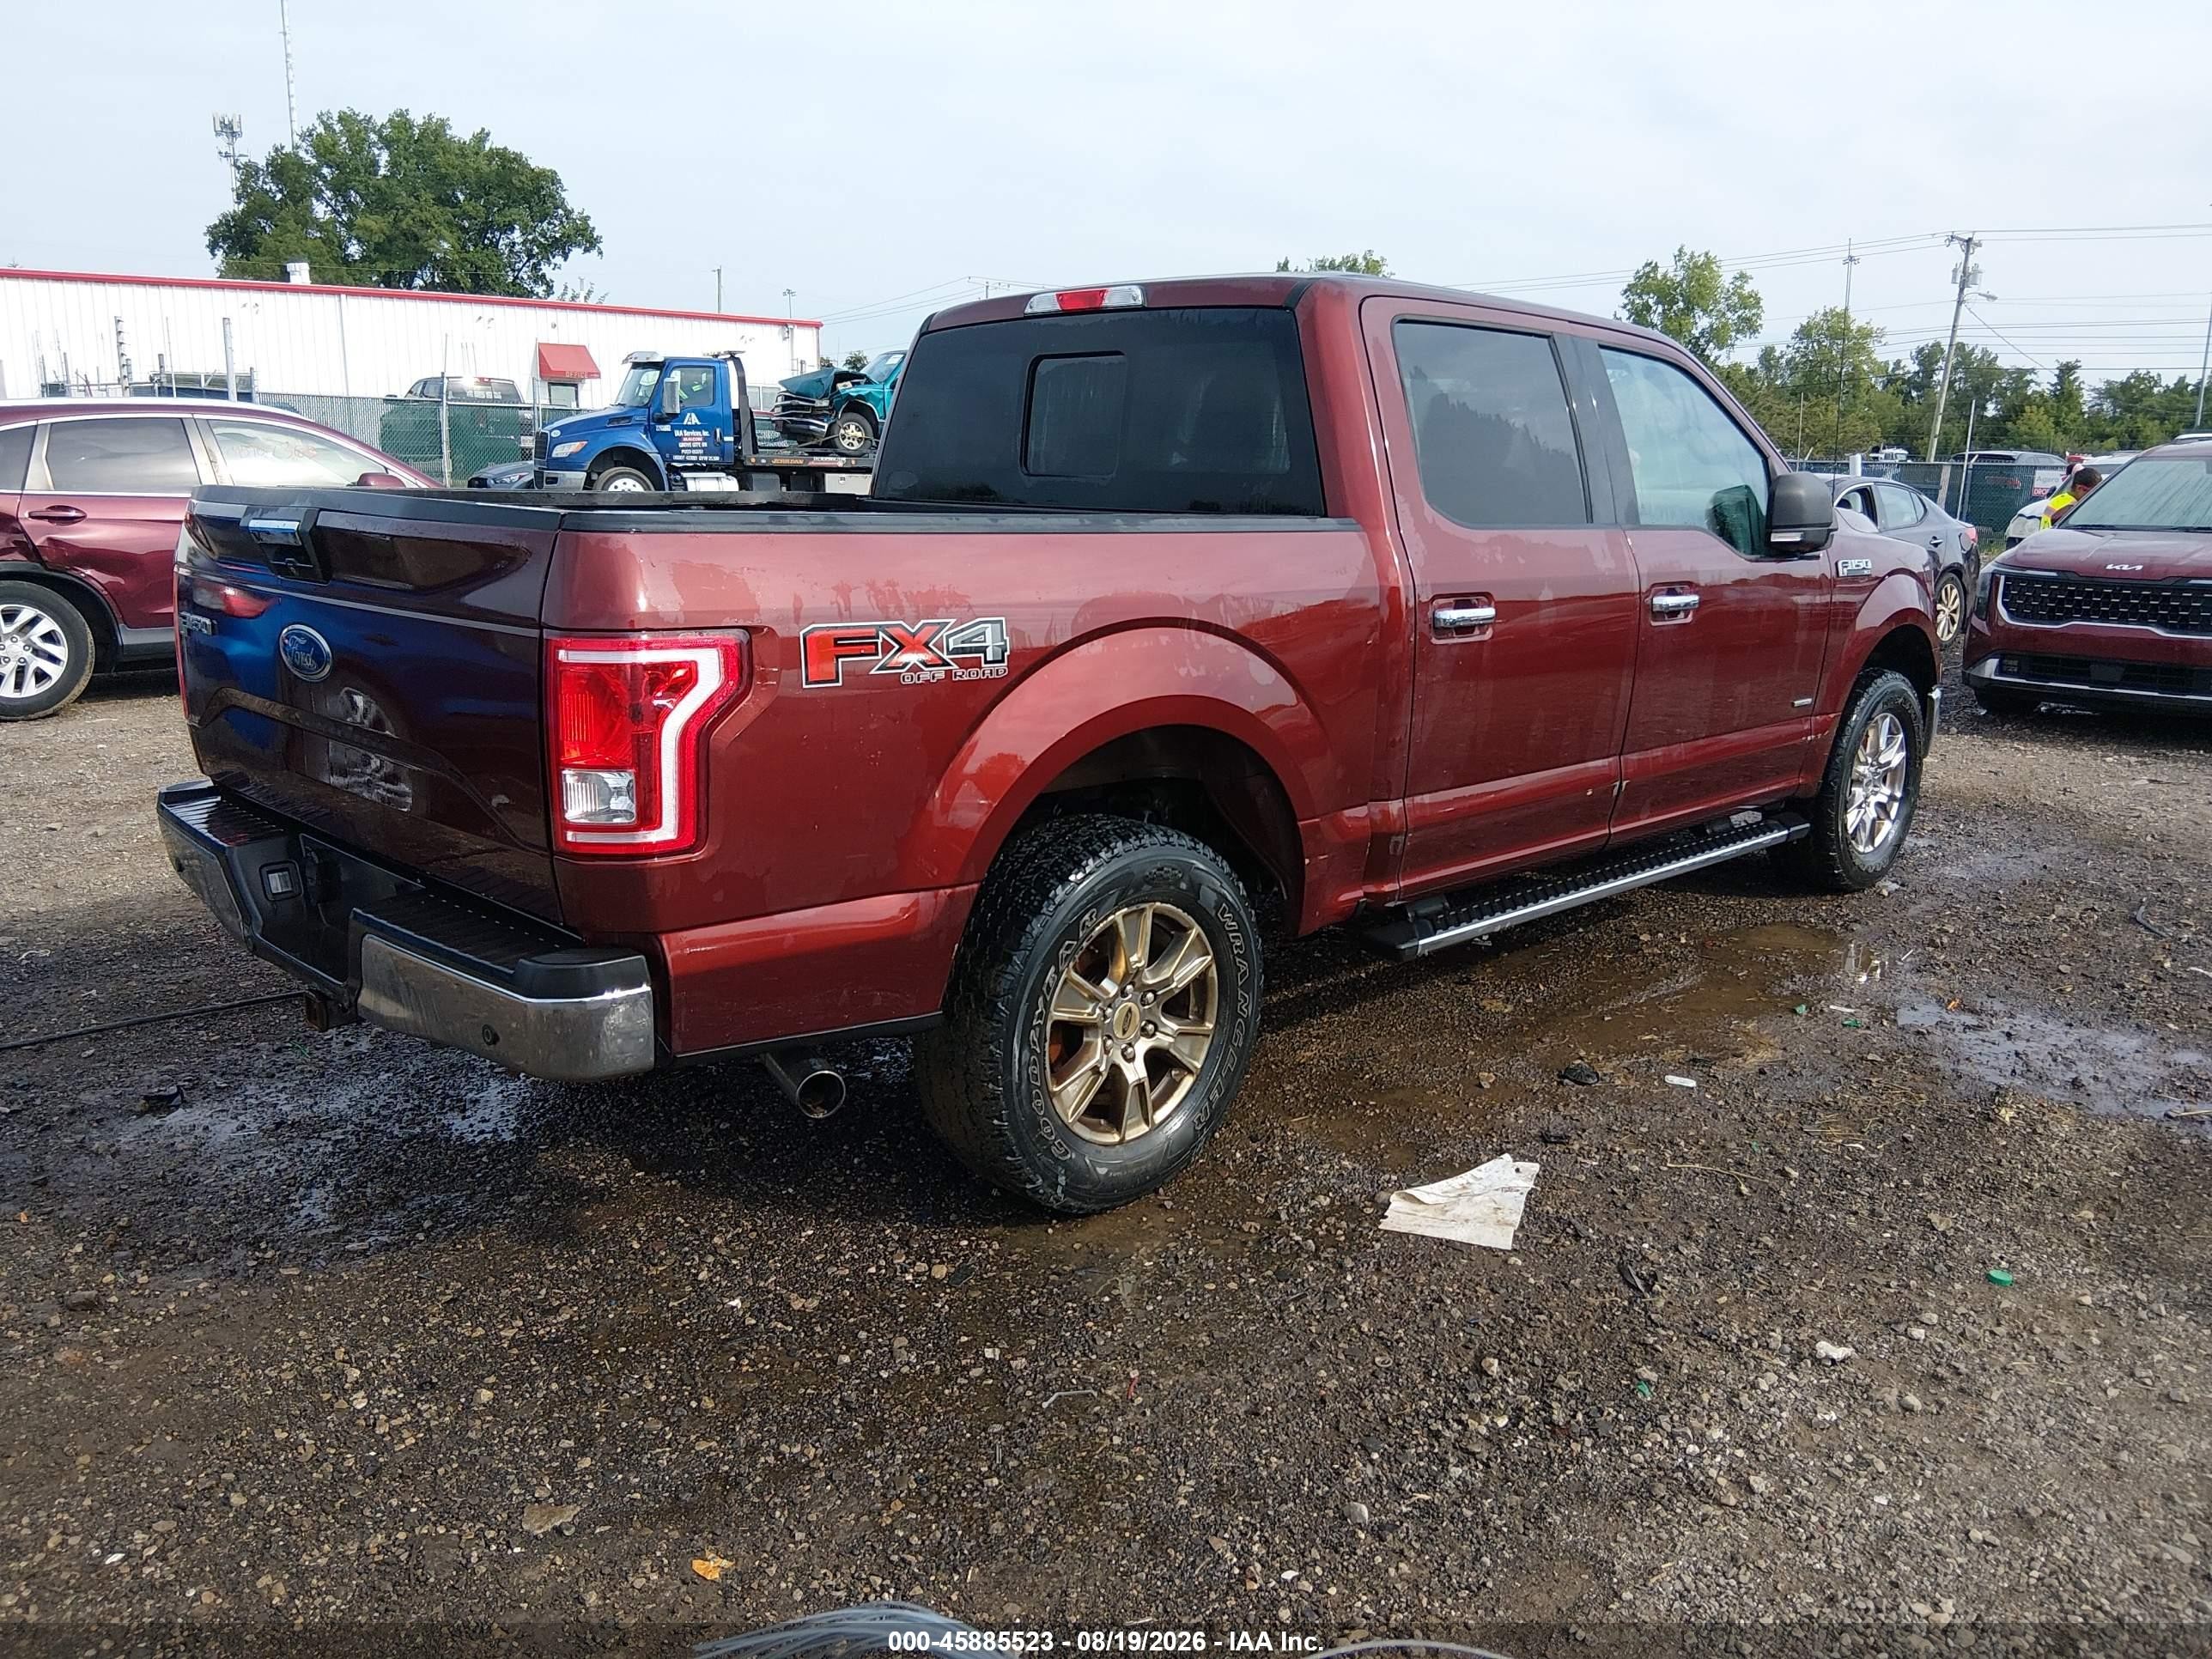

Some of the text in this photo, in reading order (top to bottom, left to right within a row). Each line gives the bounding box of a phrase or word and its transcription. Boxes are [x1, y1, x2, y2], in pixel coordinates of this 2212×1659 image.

[799, 617, 1010, 689] FX4
[900, 666, 1008, 684] OFF ROAD
[1030, 908, 1097, 1159] GOODYEAR
[1193, 903, 1249, 1130] WRANGLER
